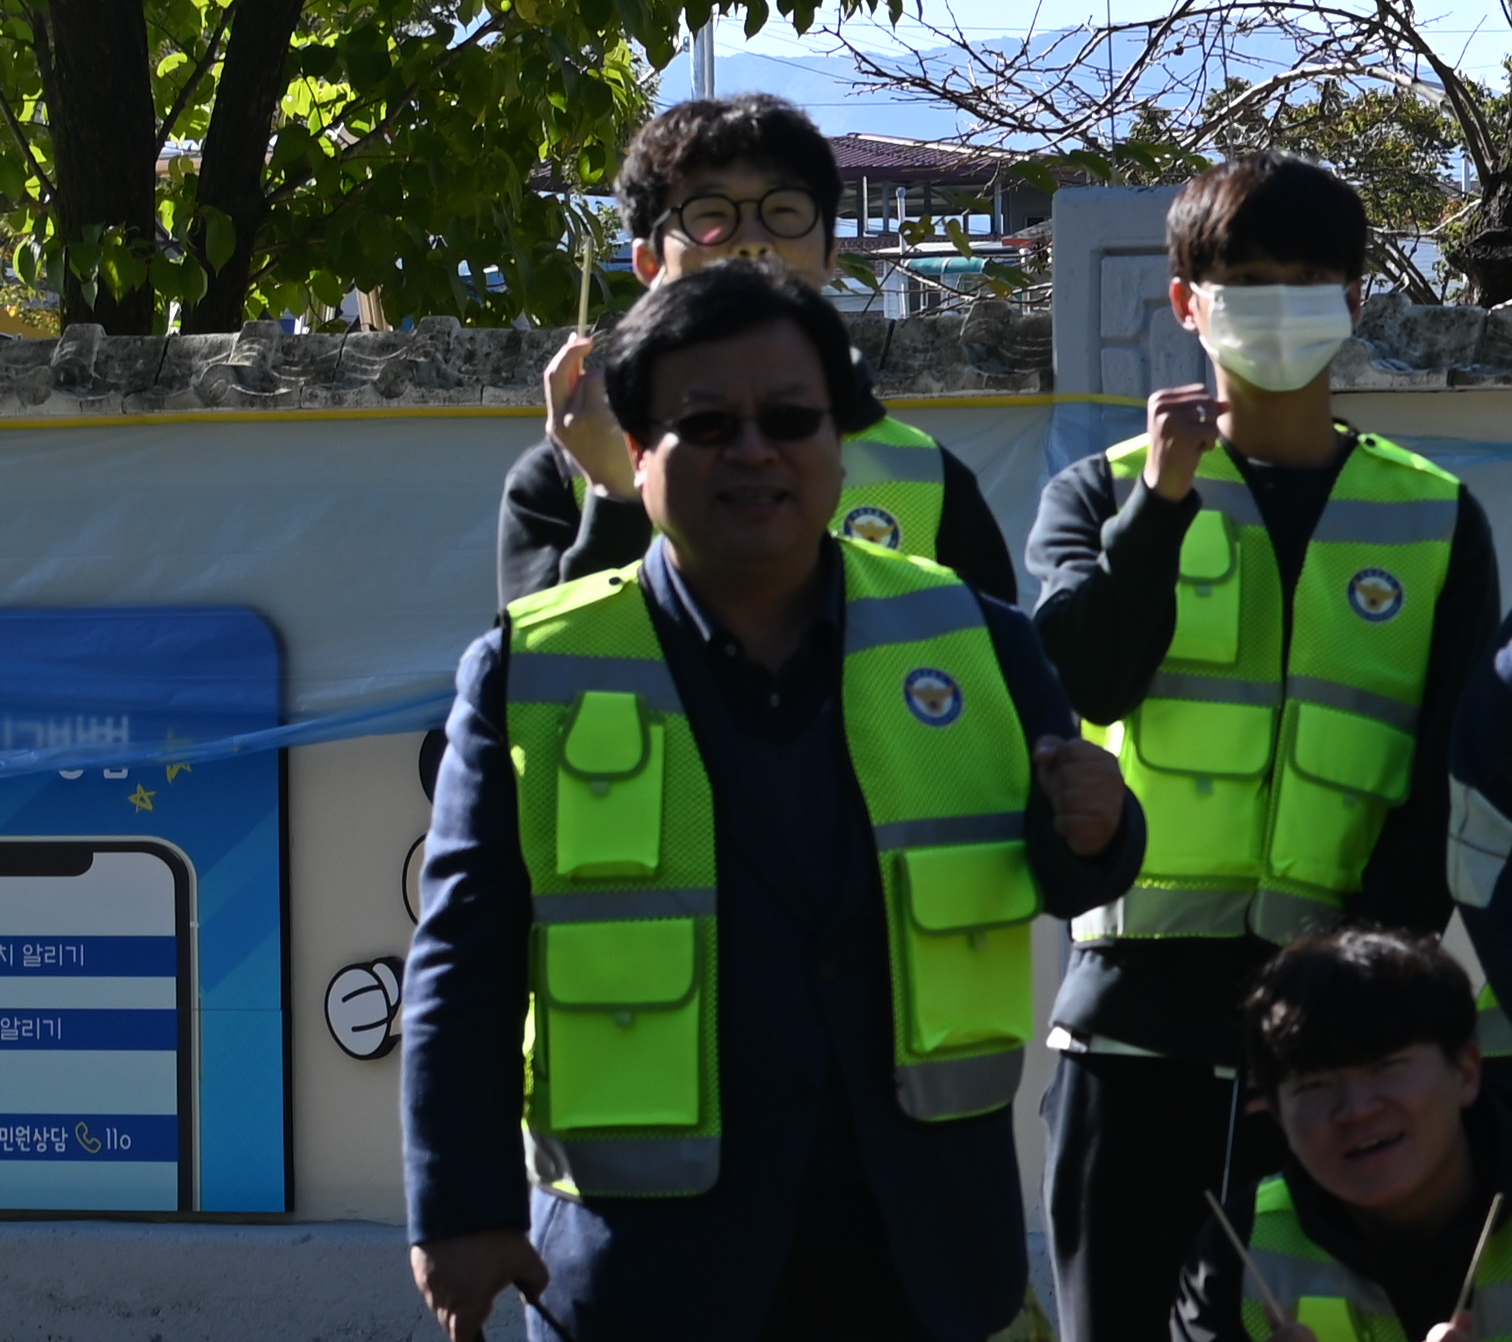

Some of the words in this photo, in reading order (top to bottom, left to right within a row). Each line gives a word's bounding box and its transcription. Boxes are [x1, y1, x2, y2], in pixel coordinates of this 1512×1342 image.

[23, 943, 84, 967] 알리기
[0, 1016, 61, 1041] 알리기
[0, 1125, 68, 1152] 민원상담
[106, 1127, 132, 1150] 110
